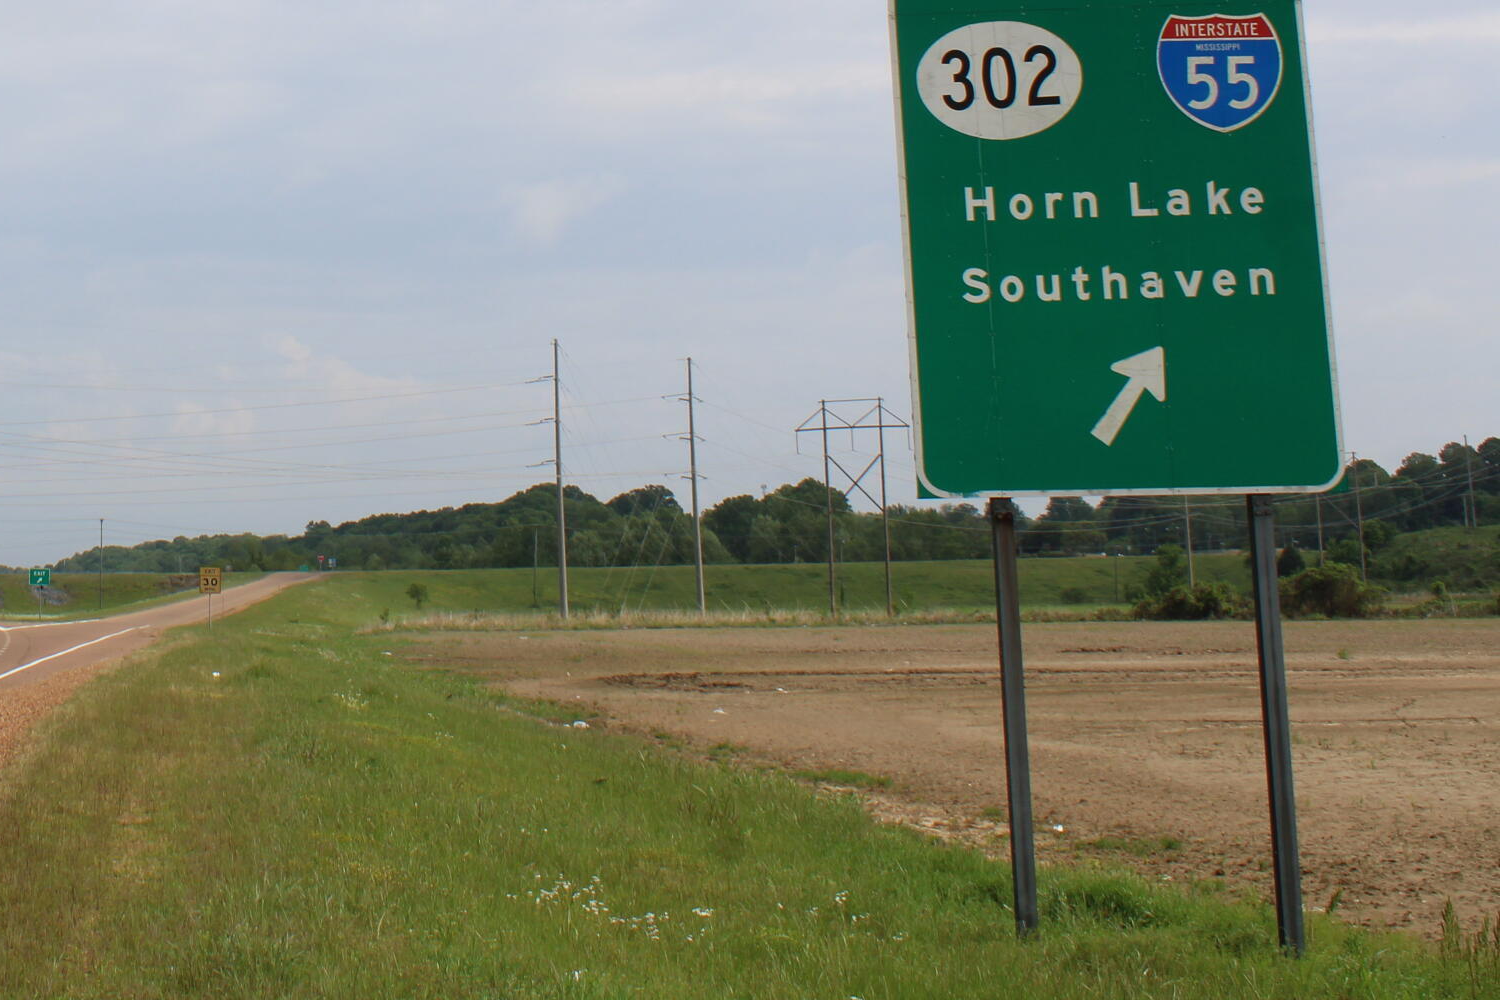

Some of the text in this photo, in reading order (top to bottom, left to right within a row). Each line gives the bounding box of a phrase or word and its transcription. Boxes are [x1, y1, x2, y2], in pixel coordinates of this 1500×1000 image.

[1175, 22, 1259, 37] INTERSTATE
[1195, 43, 1241, 51] MISSISSIPPI
[940, 44, 1062, 111] 302
[1187, 55, 1259, 110] 55
[964, 180, 1265, 222] Horn Lake
[962, 265, 1276, 304] Southaven
[203, 577, 218, 586] 30
